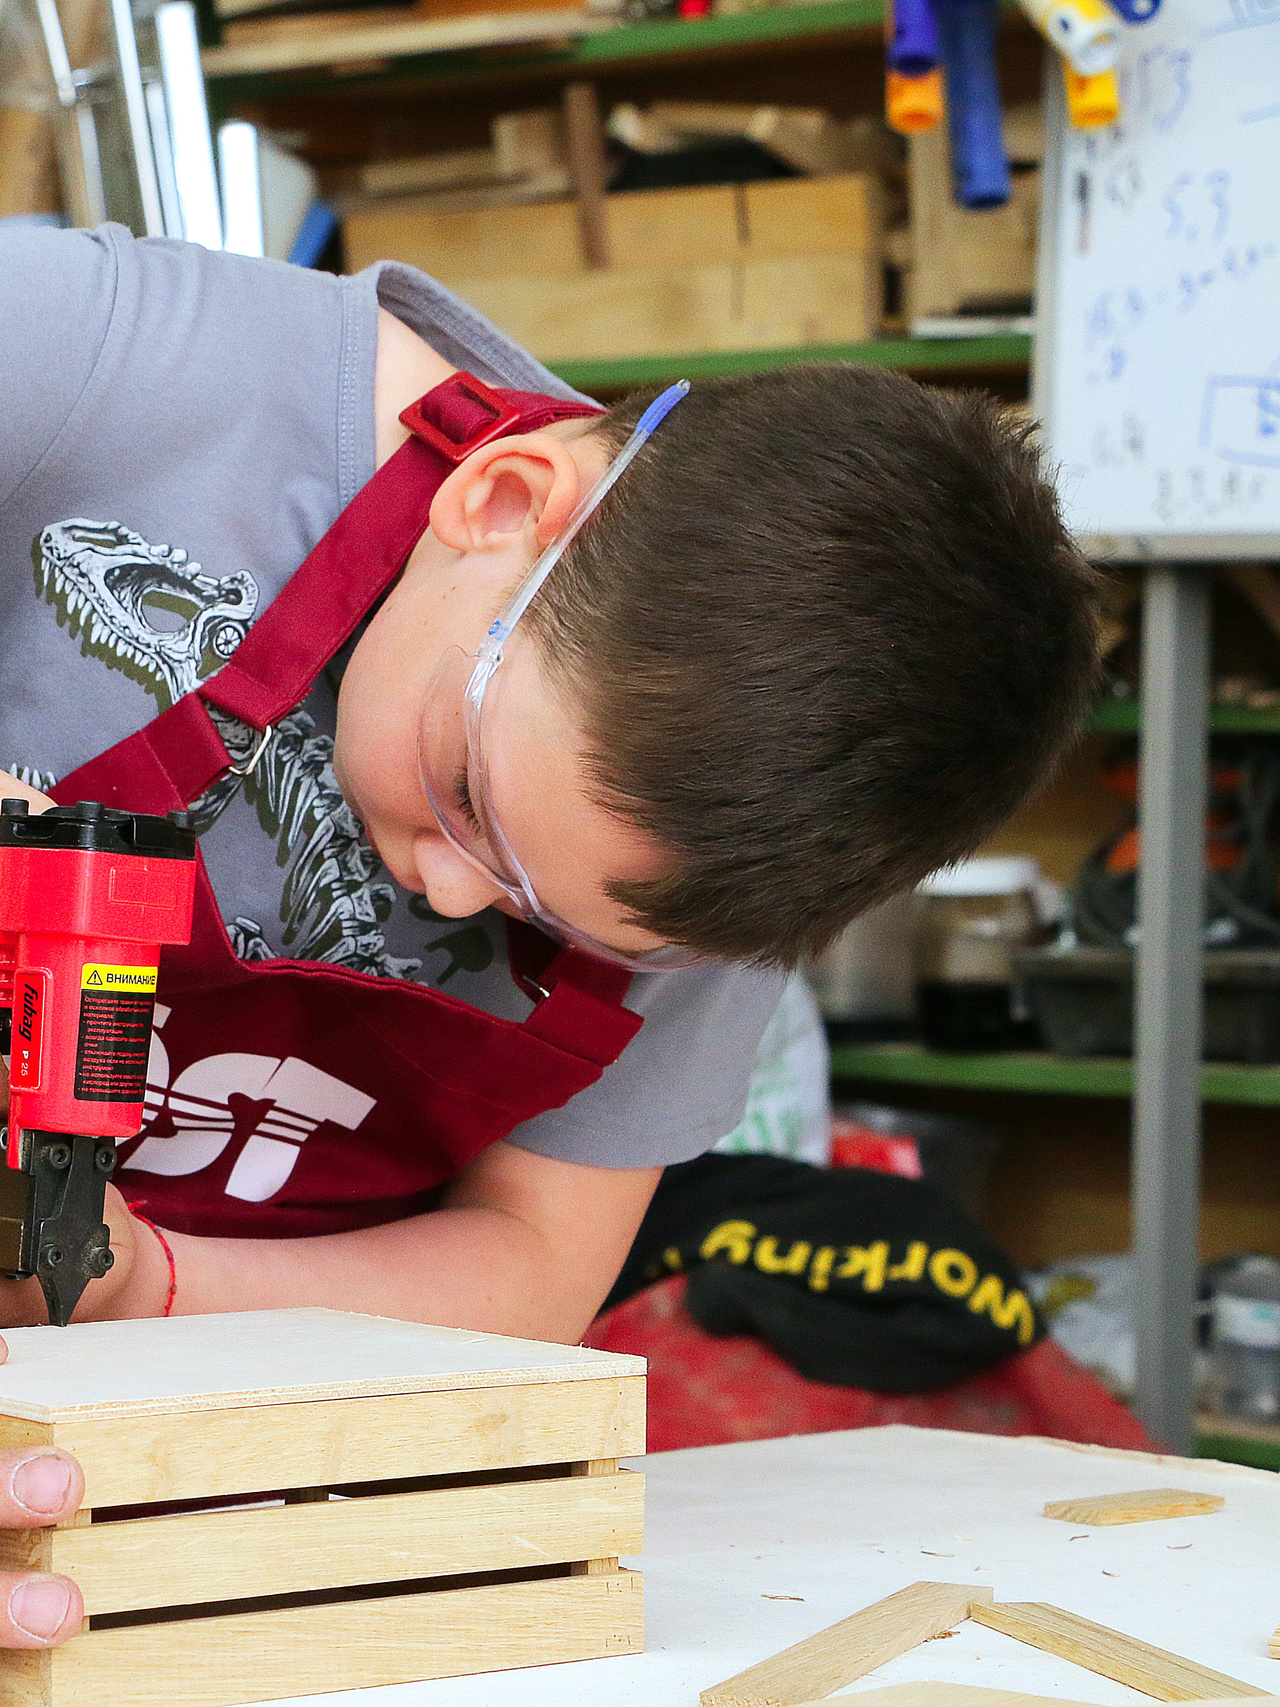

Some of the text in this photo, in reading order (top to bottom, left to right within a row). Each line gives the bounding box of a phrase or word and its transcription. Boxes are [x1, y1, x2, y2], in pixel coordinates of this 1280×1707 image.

[106, 973, 156, 986] ВНИМАНИЕ
[19, 983, 39, 1042] fubag
[22, 1050, 30, 1060] P
